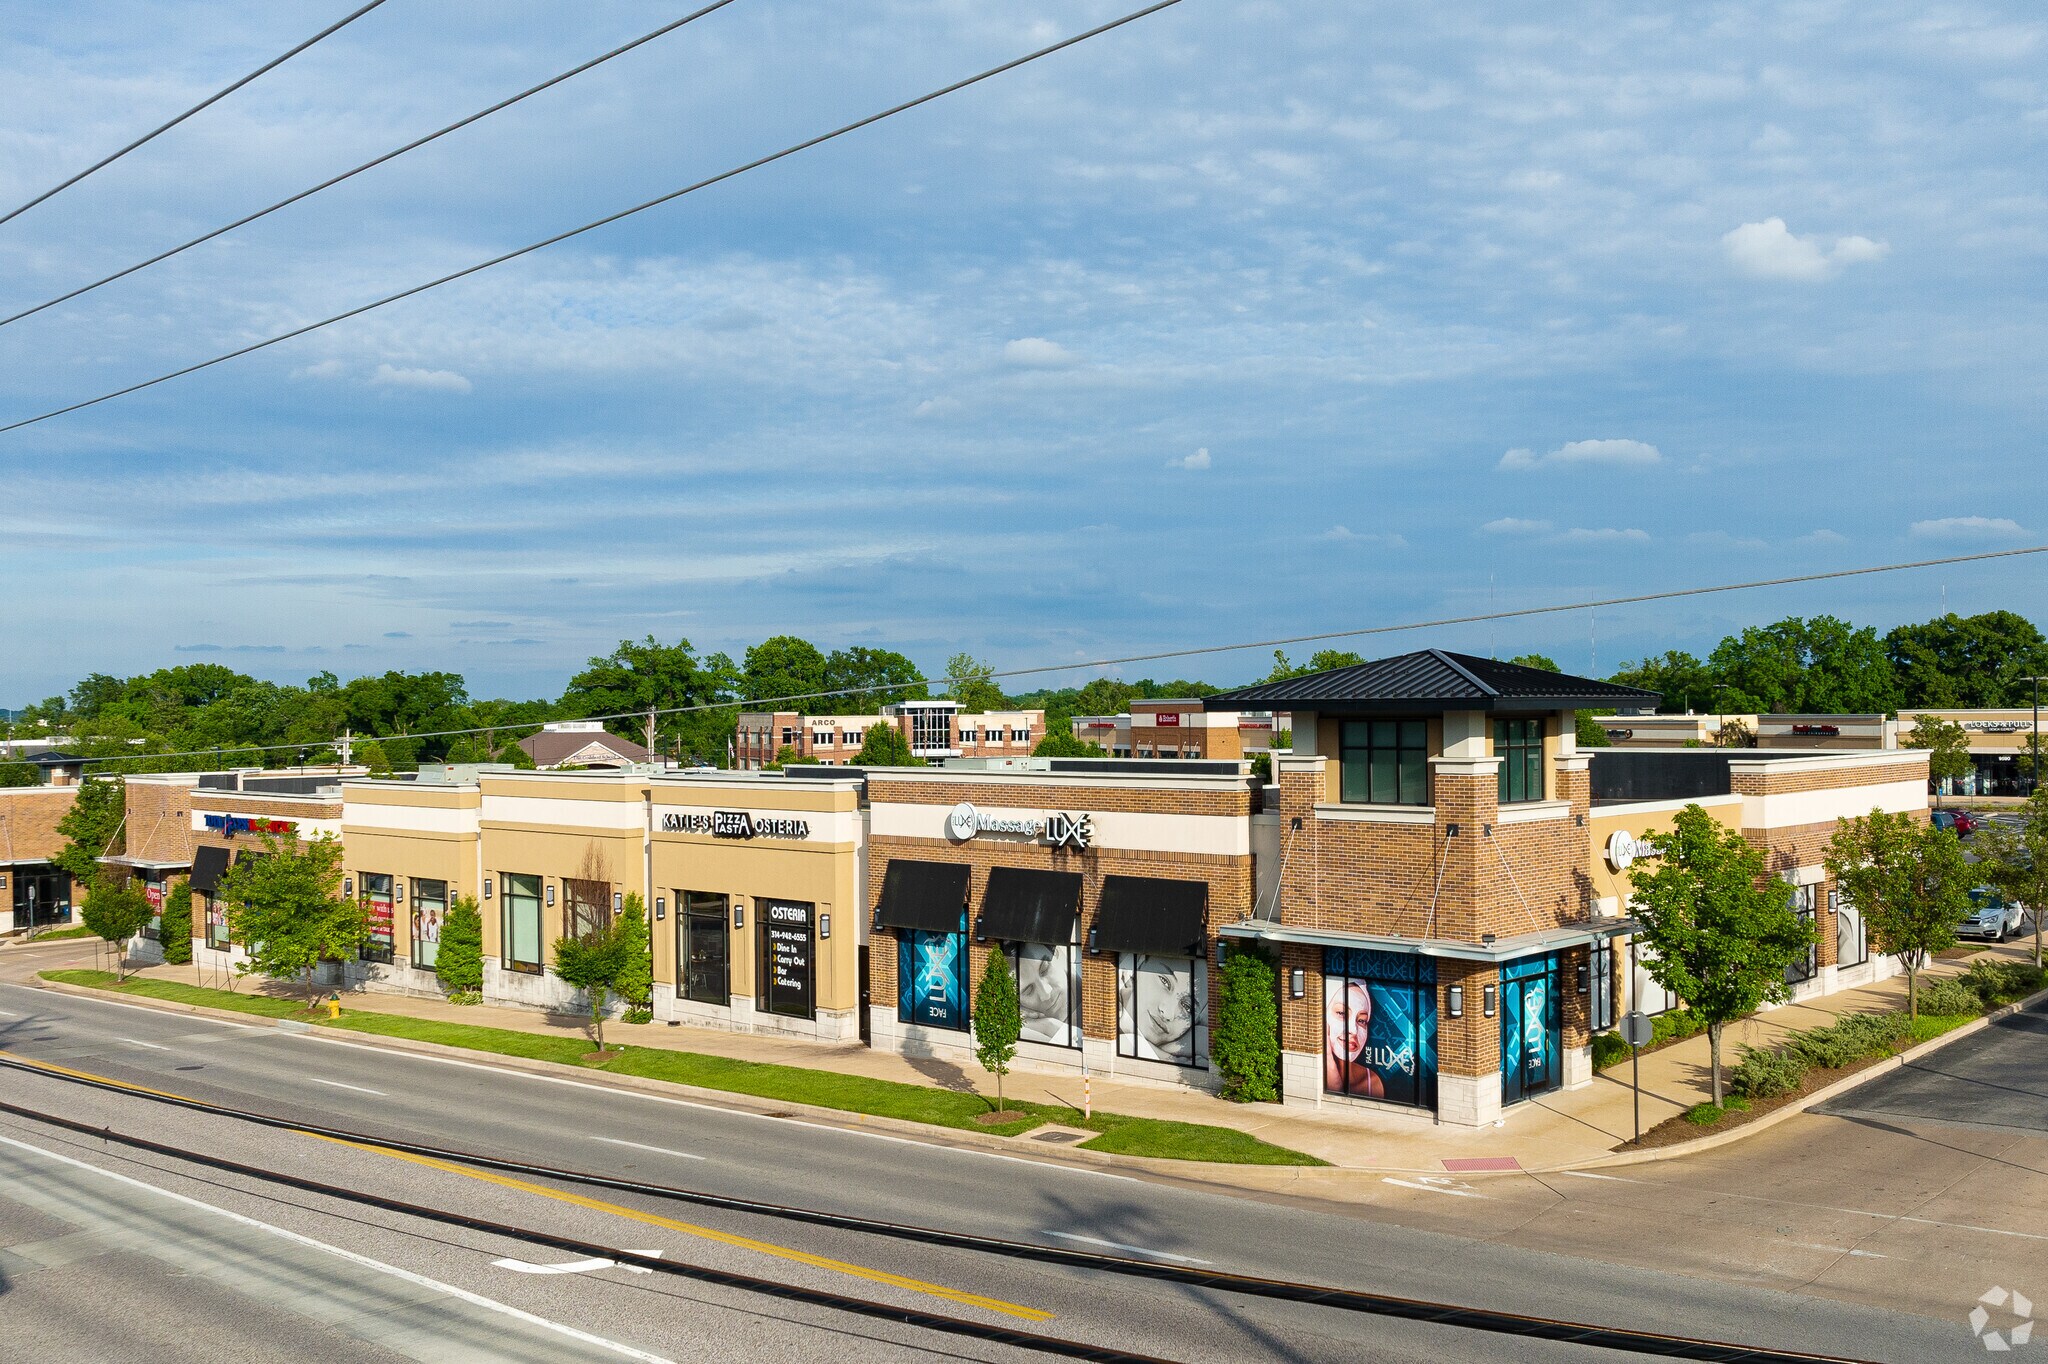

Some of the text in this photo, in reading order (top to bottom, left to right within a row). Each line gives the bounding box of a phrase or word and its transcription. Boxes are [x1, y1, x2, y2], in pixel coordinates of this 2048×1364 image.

[662, 813, 709, 830] KATIE'S
[754, 818, 807, 836] OSTERIA
[976, 813, 1040, 836] Massage
[1046, 812, 1088, 848] LUXE
[147, 888, 161, 902] Open
[771, 906, 806, 922] OSTERIA
[770, 930, 807, 942] 314-942-6555
[776, 943, 798, 954] Dine In
[777, 954, 805, 966] Carry Out
[777, 966, 787, 976] Bar
[925, 944, 950, 1002] LUXE
[777, 976, 801, 991] Catering
[929, 1006, 947, 1018] FACE
[1525, 994, 1546, 1053] LUXE
[1374, 1045, 1409, 1073] LUXE
